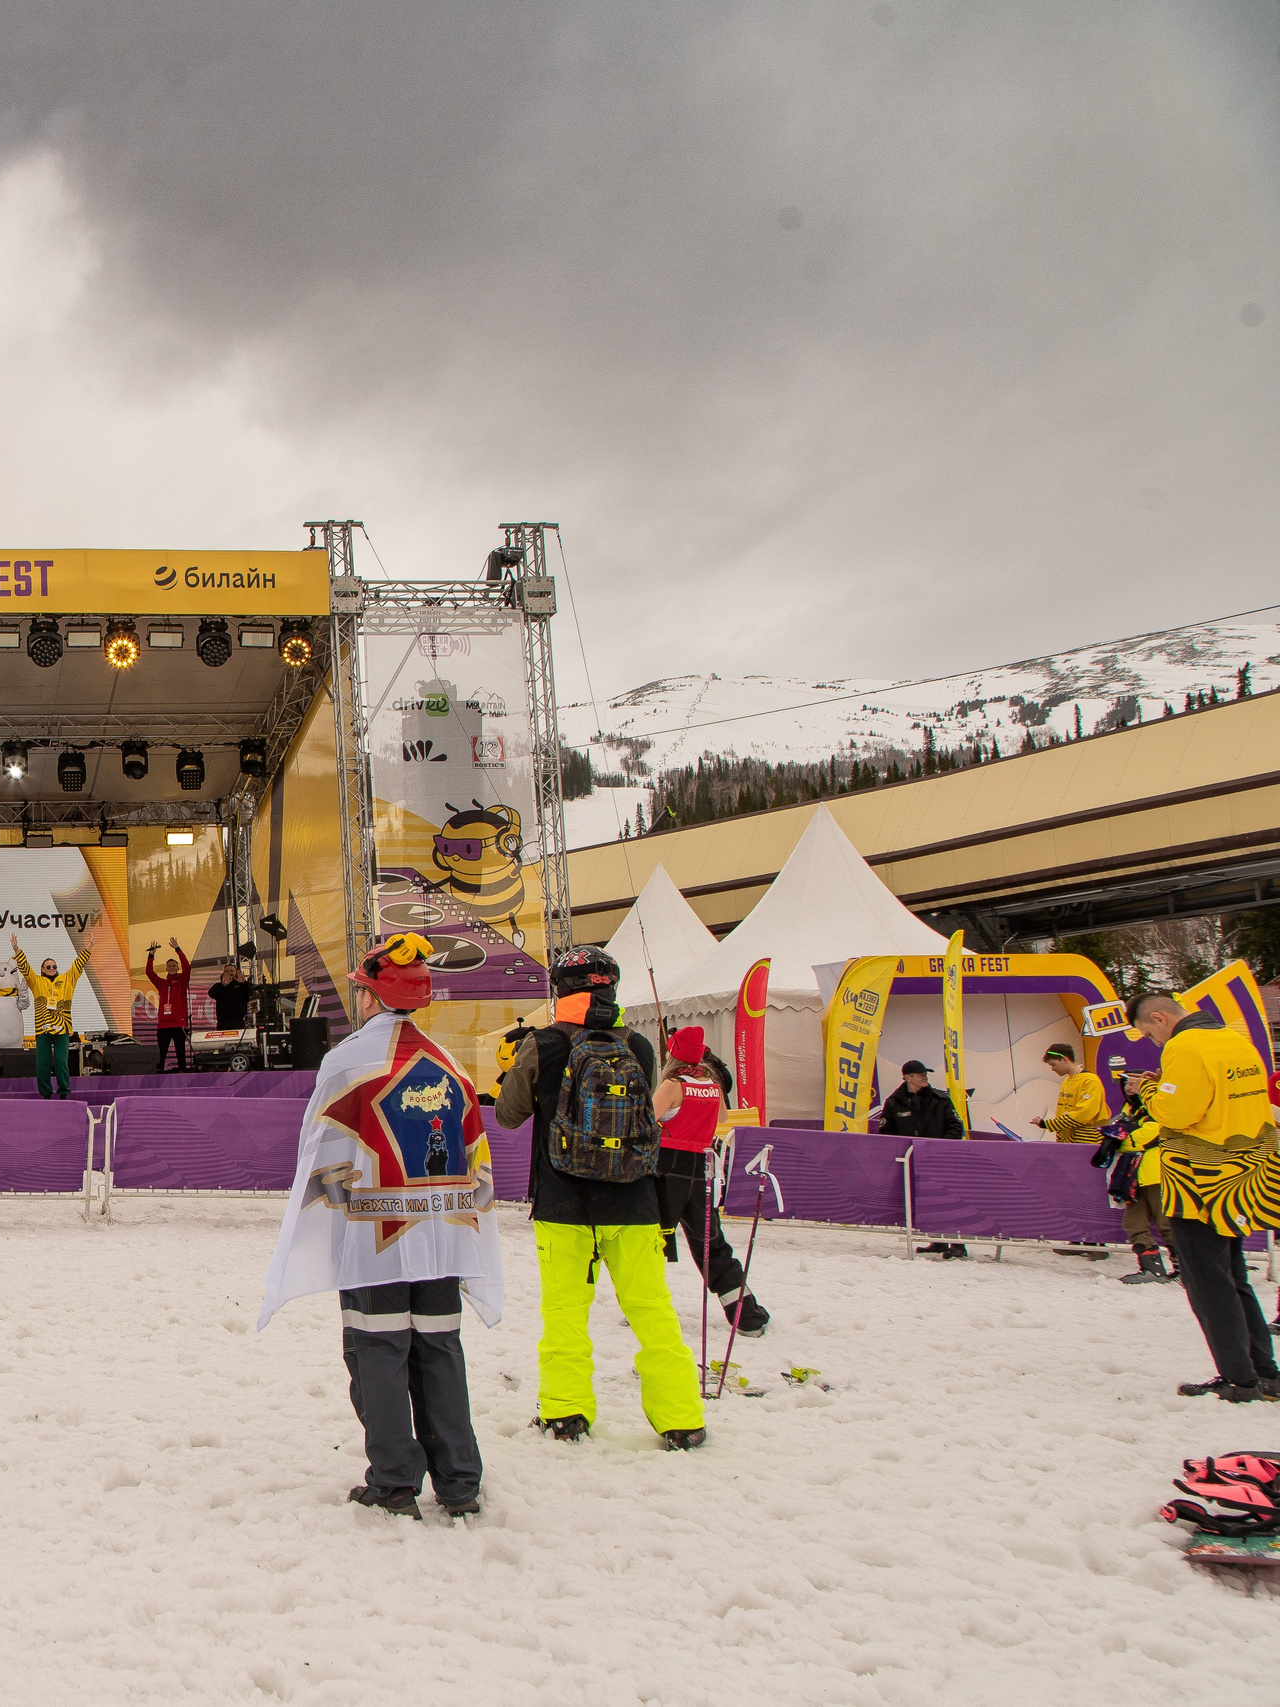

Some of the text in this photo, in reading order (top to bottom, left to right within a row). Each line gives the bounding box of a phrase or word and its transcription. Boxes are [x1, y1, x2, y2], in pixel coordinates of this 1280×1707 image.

[185, 565, 276, 590] билайн
[422, 636, 449, 645] GRELKA
[422, 645, 441, 654] FEST
[392, 696, 450, 713] drivee
[465, 701, 506, 710] MOUNTAIN
[928, 957, 1010, 973] GRKA FEST
[409, 1091, 442, 1103] РОССИЯ
[685, 1086, 720, 1098] ЛУКОЙЛ
[405, 1198, 429, 1213] им
[431, 1194, 441, 1212] С
[444, 1193, 454, 1211] М
